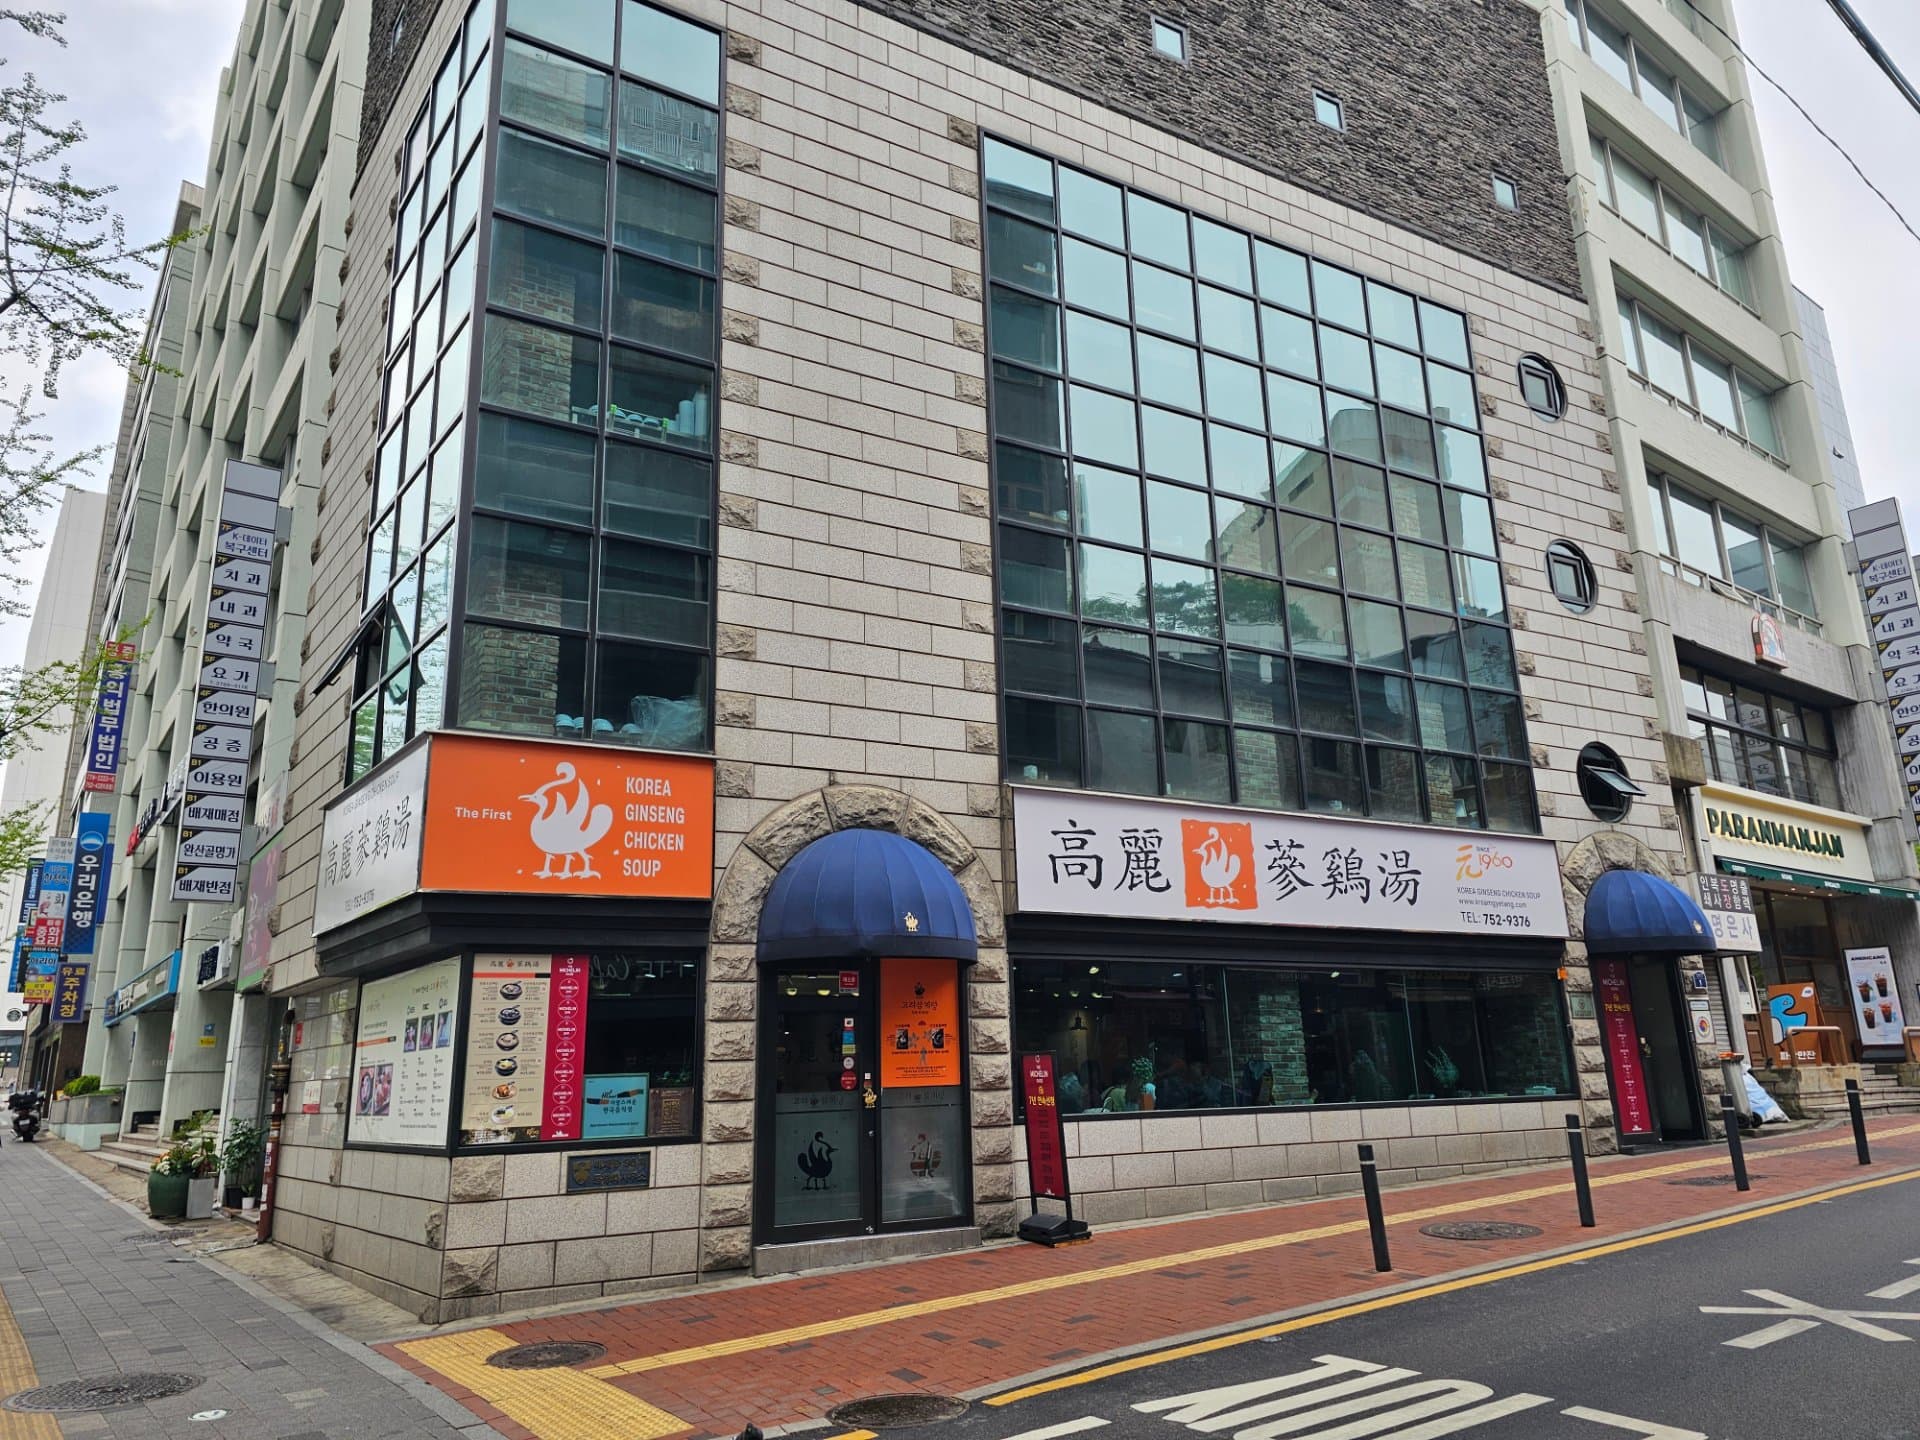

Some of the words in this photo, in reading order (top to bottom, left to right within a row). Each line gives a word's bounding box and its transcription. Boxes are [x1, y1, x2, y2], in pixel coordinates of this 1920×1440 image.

[232, 532, 267, 546] K-데이터
[224, 568, 261, 586] 치과
[220, 600, 257, 617] 내과
[1882, 617, 1914, 633] 내과
[216, 633, 253, 651] 약국
[211, 666, 250, 683] 요가
[203, 701, 250, 719] 한의원
[203, 736, 241, 753] 공증
[193, 771, 242, 788] 이용원
[626, 776, 671, 796] KOREA
[188, 806, 240, 823] 배재매점
[455, 807, 478, 820] The
[482, 808, 512, 821] First
[625, 804, 685, 824] GINSENG
[624, 831, 684, 851] CHICKEN
[183, 843, 236, 860] 완산골명가
[1048, 819, 1172, 893] 高麗
[623, 858, 661, 877] SOUP
[1478, 852, 1513, 870] 1960
[71, 854, 100, 928] 우리은행
[178, 879, 232, 895] 배재반점
[1457, 886, 1476, 895] KOREA
[1477, 888, 1501, 897] GINSENG
[1502, 890, 1526, 898] CHICKEN
[1526, 892, 1541, 900] SOUP
[1461, 911, 1481, 924] TEL:
[1483, 913, 1531, 928] 752-9376
[60, 977, 80, 1017] 주차장
